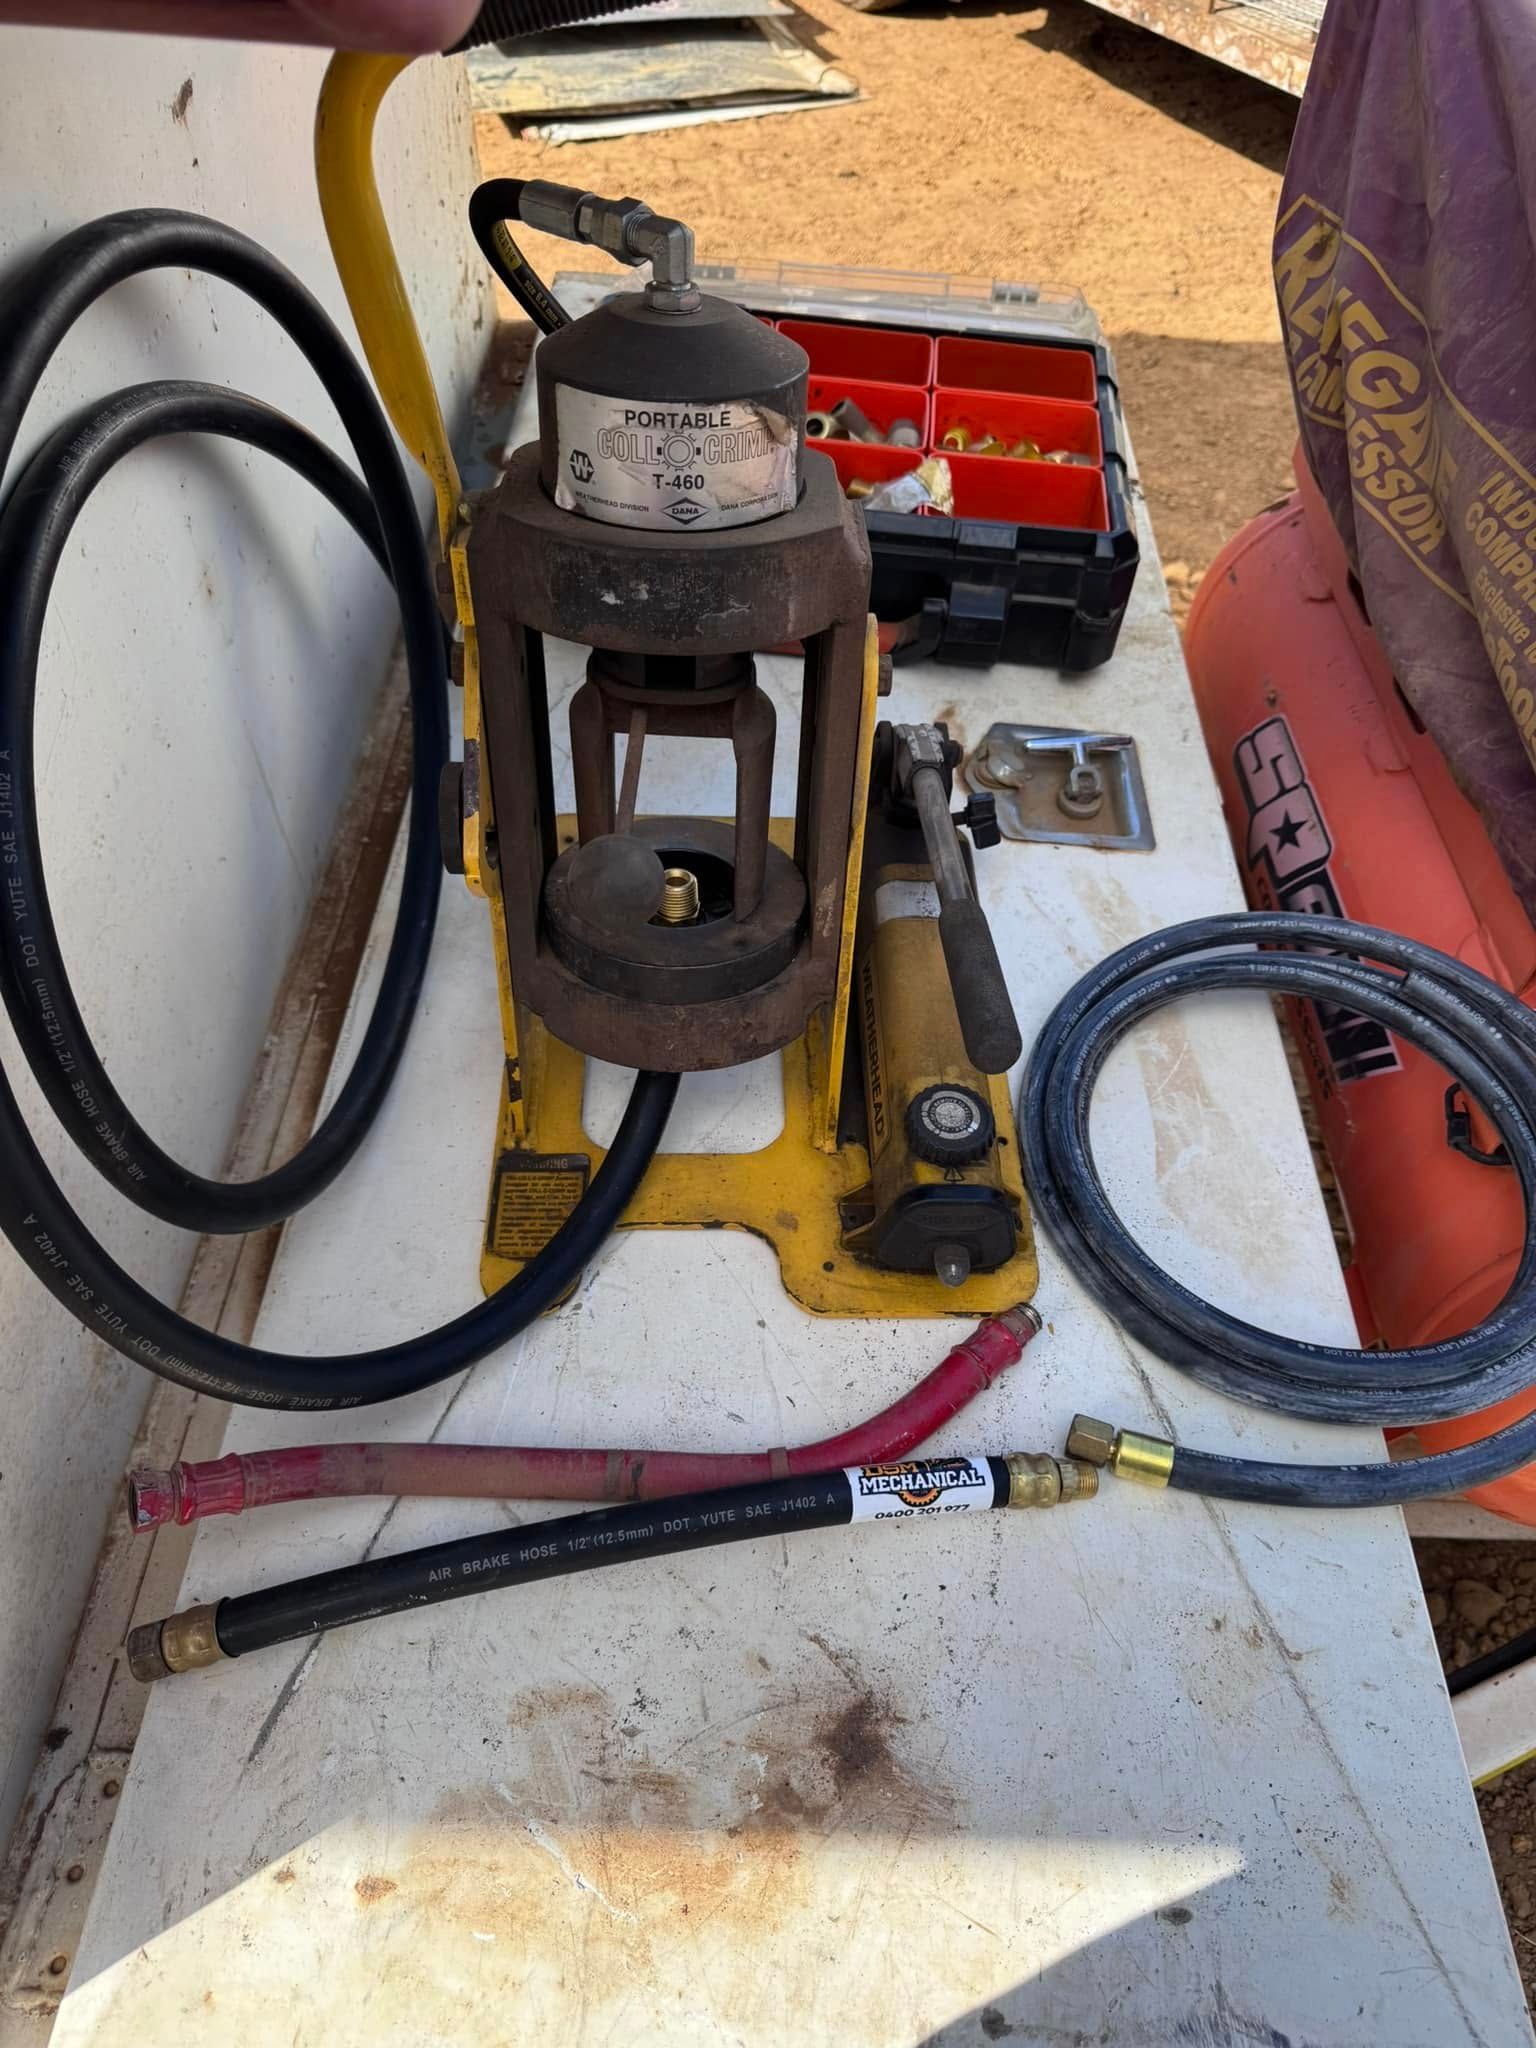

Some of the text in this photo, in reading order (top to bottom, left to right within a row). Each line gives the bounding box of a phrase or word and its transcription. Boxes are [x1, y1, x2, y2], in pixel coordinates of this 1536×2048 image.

[624, 409, 731, 429] PORTABLE
[652, 473, 705, 490] T-460
[619, 500, 650, 513] DIVISION
[671, 506, 699, 516] DANA
[721, 503, 739, 512] DANA
[1474, 566, 1531, 644] Exclusive
[2, 831, 18, 864] SAE
[8, 876, 28, 921] YUTE
[19, 935, 40, 968] DOT
[861, 960, 885, 1137] WEATHERHEAD
[71, 1079, 100, 1119] HOSE
[95, 1121, 129, 1162] BRAKE
[127, 1162, 148, 1181] AIR
[23, 1212, 39, 1225] A
[34, 1231, 69, 1269] J1402
[66, 1274, 94, 1301] SAE
[95, 1303, 128, 1334] YUTE
[131, 1335, 161, 1357] DOT
[1360, 1352, 1378, 1360] AIR
[1378, 1352, 1411, 1360] BRAKE
[247, 1389, 283, 1405] HOSE
[861, 1469, 984, 1494] MECHANICAL
[874, 1503, 970, 1520] 0400 201 977
[428, 1567, 452, 1583] AIR
[462, 1553, 511, 1575] BRAKE
[520, 1543, 559, 1561] HOSE
[663, 1517, 690, 1534] DOT
[701, 1509, 736, 1528] YUTE
[745, 1503, 772, 1519] SAE
[781, 1495, 817, 1513] J1402
[826, 1492, 836, 1505] A
